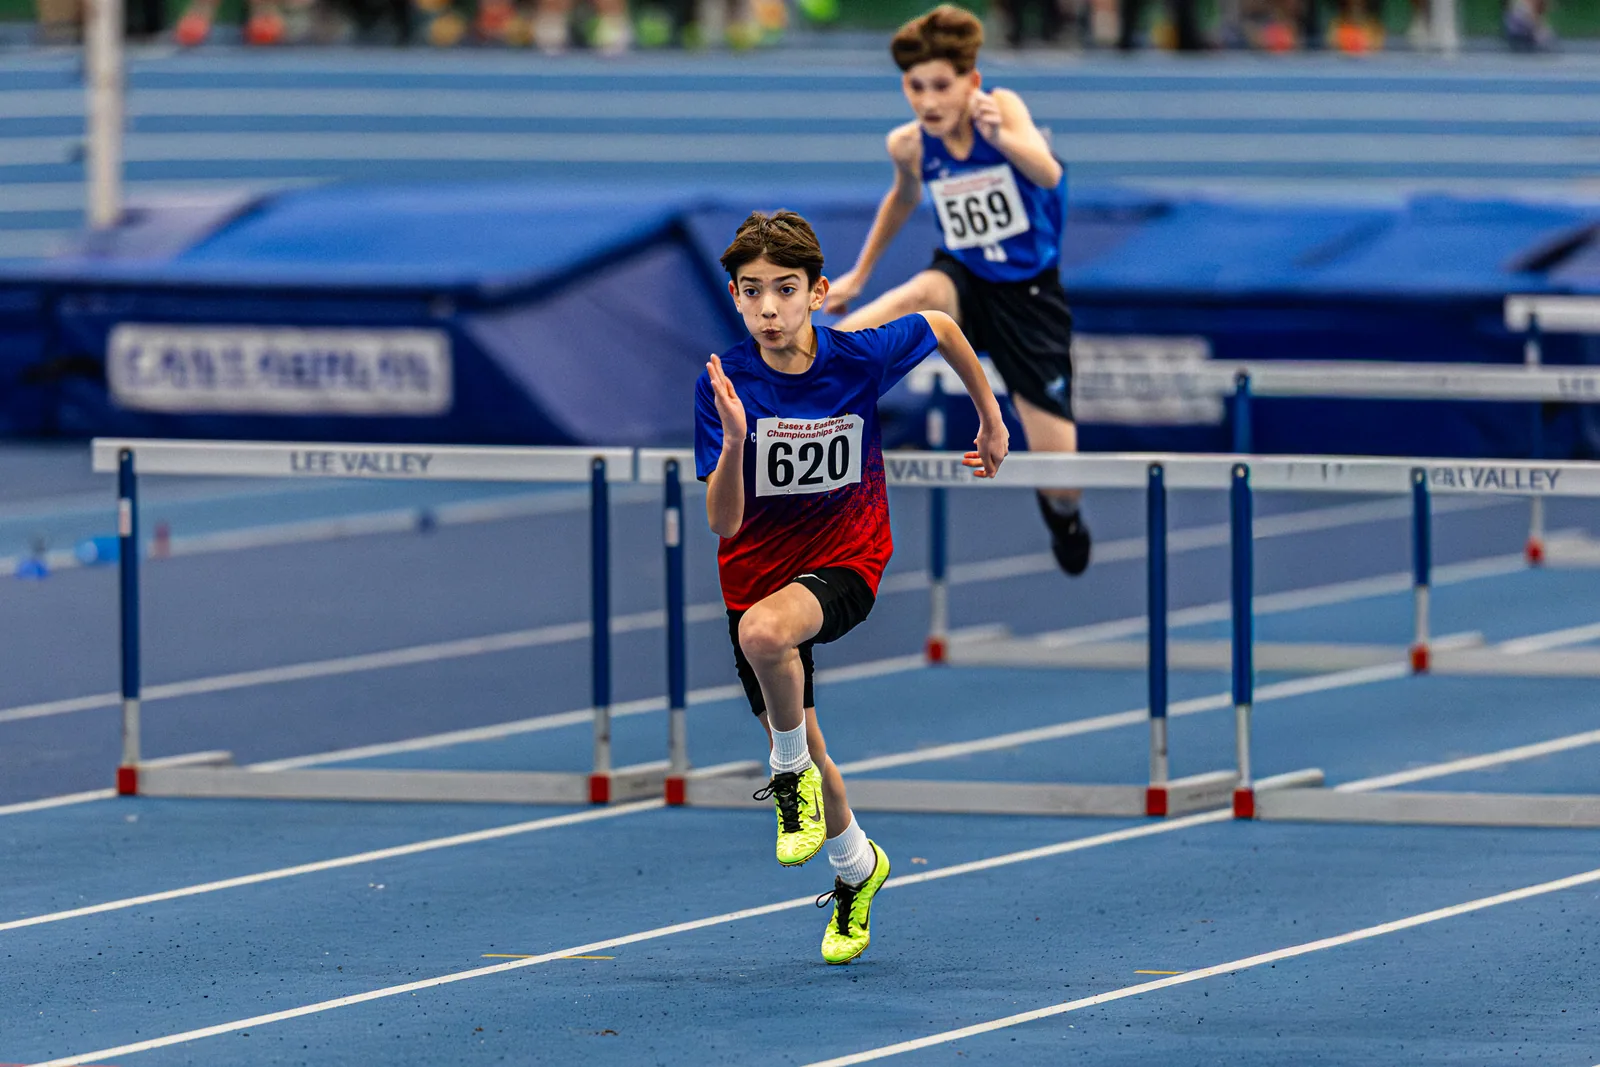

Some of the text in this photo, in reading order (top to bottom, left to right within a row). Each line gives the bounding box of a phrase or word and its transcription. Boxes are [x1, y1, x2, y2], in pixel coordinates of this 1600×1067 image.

[945, 190, 1013, 239] 569
[766, 427, 833, 440] Championships
[834, 422, 854, 433] 2026
[777, 418, 844, 431] Essex & Eastern
[290, 450, 434, 474] LEE VALLEY
[767, 434, 850, 488] 620
[887, 459, 972, 480] VALLE
[1470, 467, 1562, 491] VALLEY
